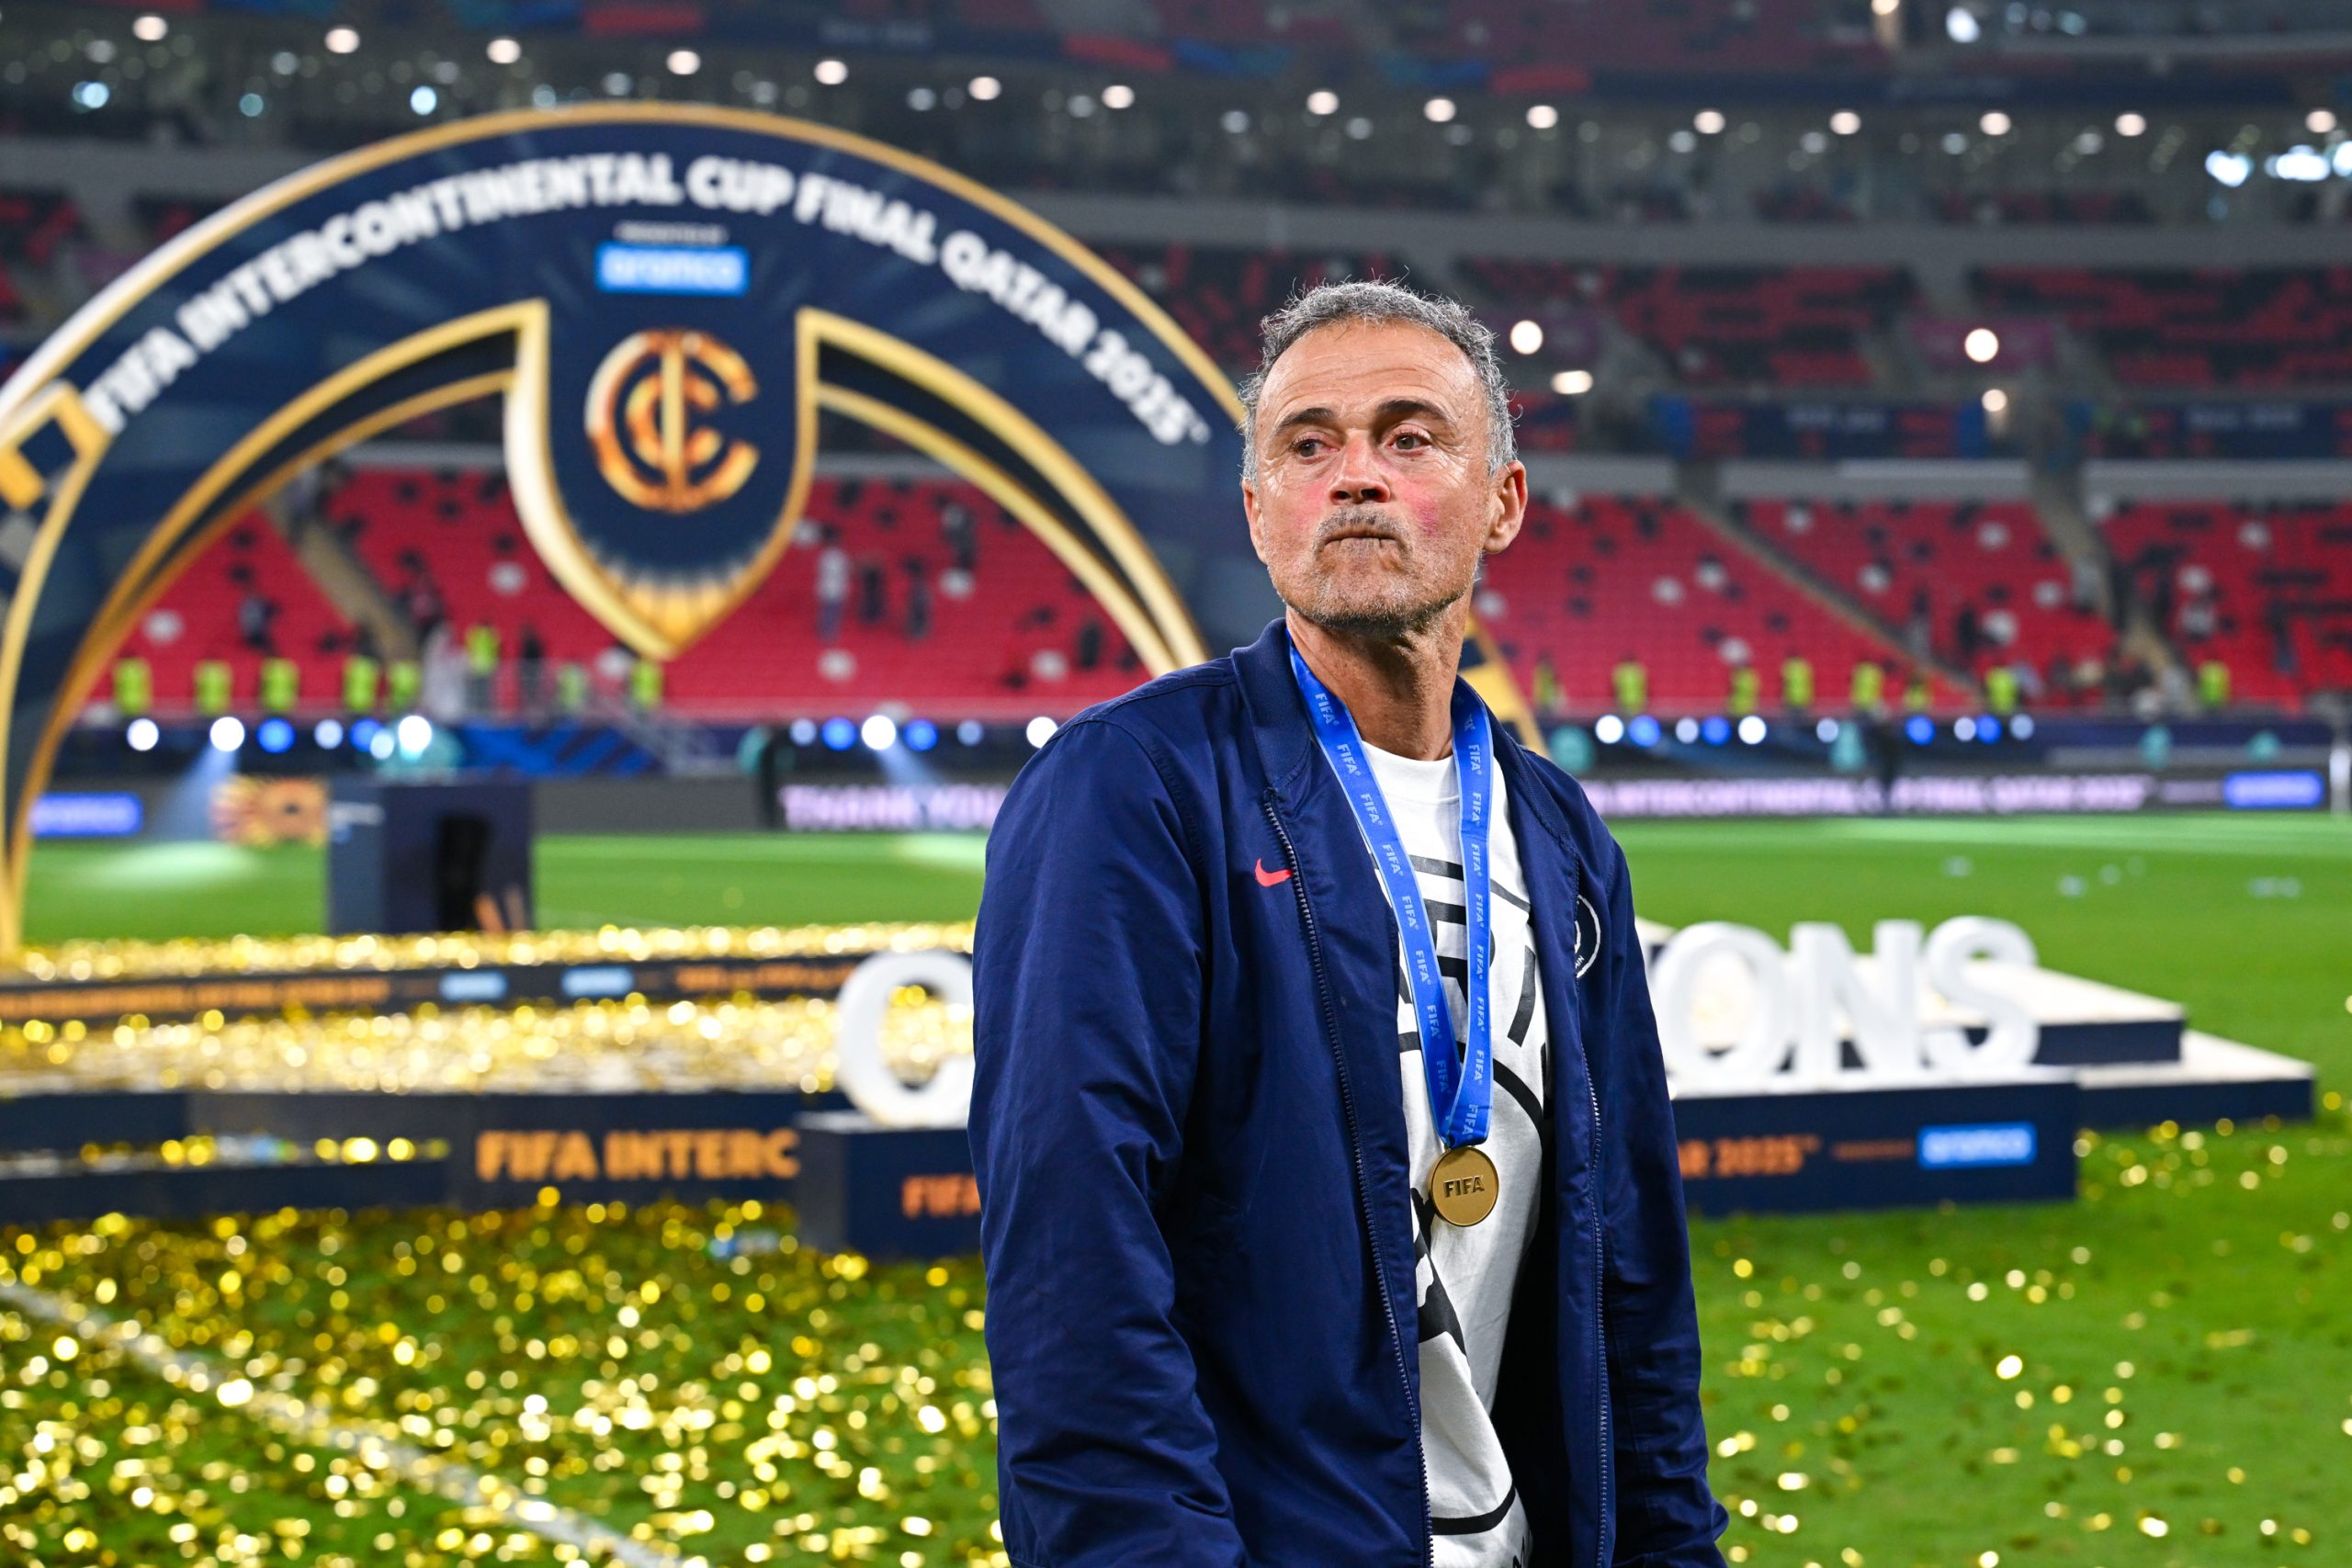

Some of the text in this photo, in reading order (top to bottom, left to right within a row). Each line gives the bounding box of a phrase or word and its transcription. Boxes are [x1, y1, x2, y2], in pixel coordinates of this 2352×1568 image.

[85, 326, 197, 434] FIFA
[175, 154, 683, 353] INTERCONTINENTAL
[686, 156, 795, 212] CUP
[795, 173, 936, 264] FINAL
[941, 231, 1099, 355] QATAR
[476, 1128, 800, 1182] FIFA INTERC
[1443, 1176, 1485, 1198] FIFA
